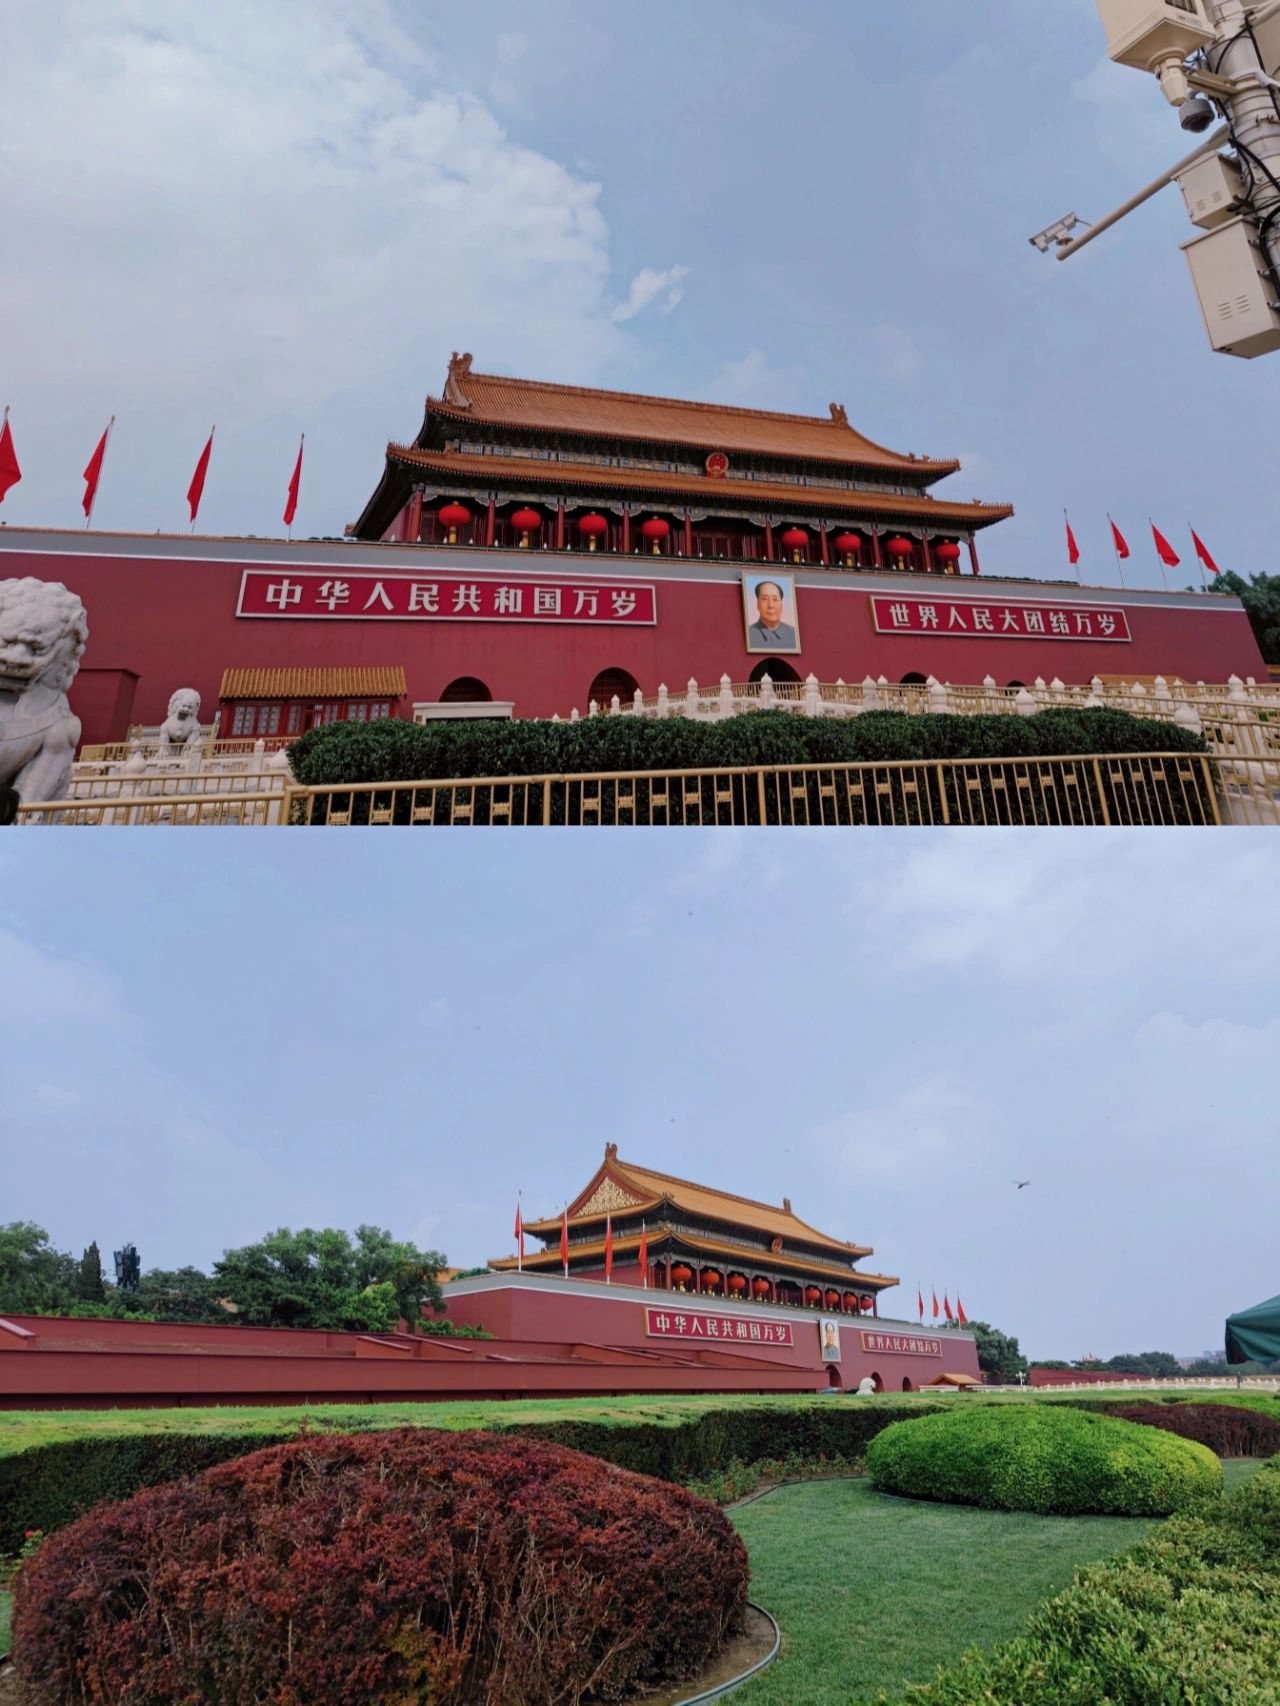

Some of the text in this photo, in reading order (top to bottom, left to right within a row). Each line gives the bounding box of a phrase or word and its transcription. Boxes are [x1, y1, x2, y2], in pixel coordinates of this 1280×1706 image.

[265, 579, 637, 617] 中华人民共和国万岁
[889, 604, 1116, 635] 世界人民大团结万岁
[656, 1314, 786, 1341] 中华人民共和国万岁
